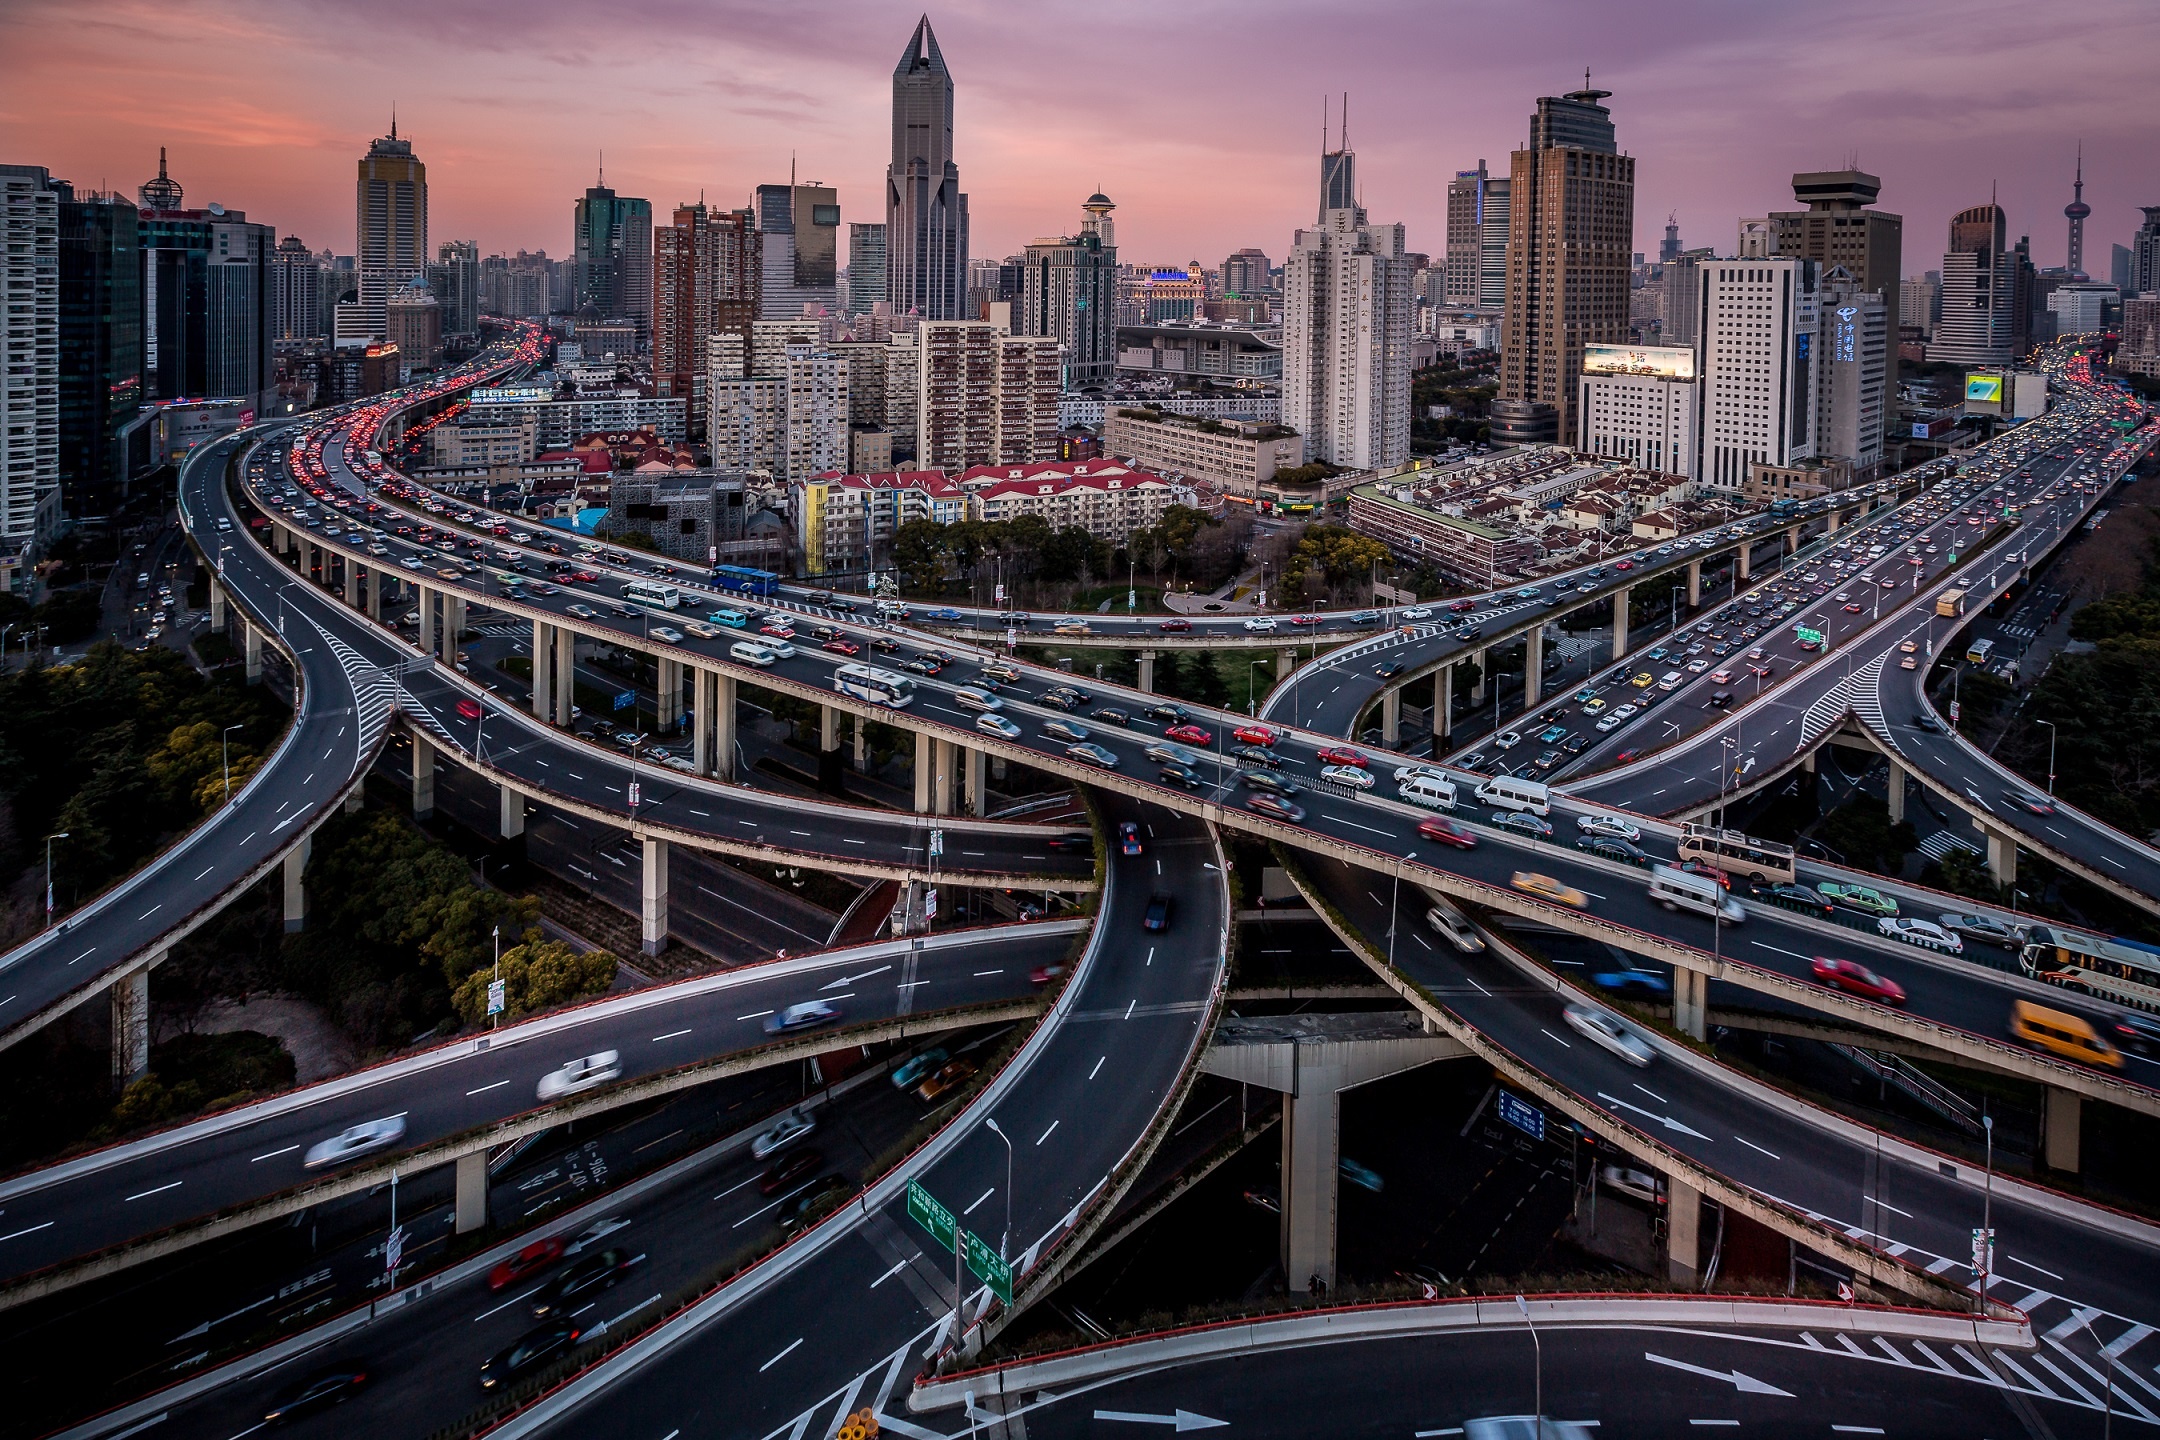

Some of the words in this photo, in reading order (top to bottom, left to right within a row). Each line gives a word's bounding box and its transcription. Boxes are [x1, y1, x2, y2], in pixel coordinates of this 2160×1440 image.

[1843, 323, 1855, 361] 中国电信
[911, 1183, 953, 1230] 共和新路立交
[970, 1238, 1009, 1279] 卢浦大桥
